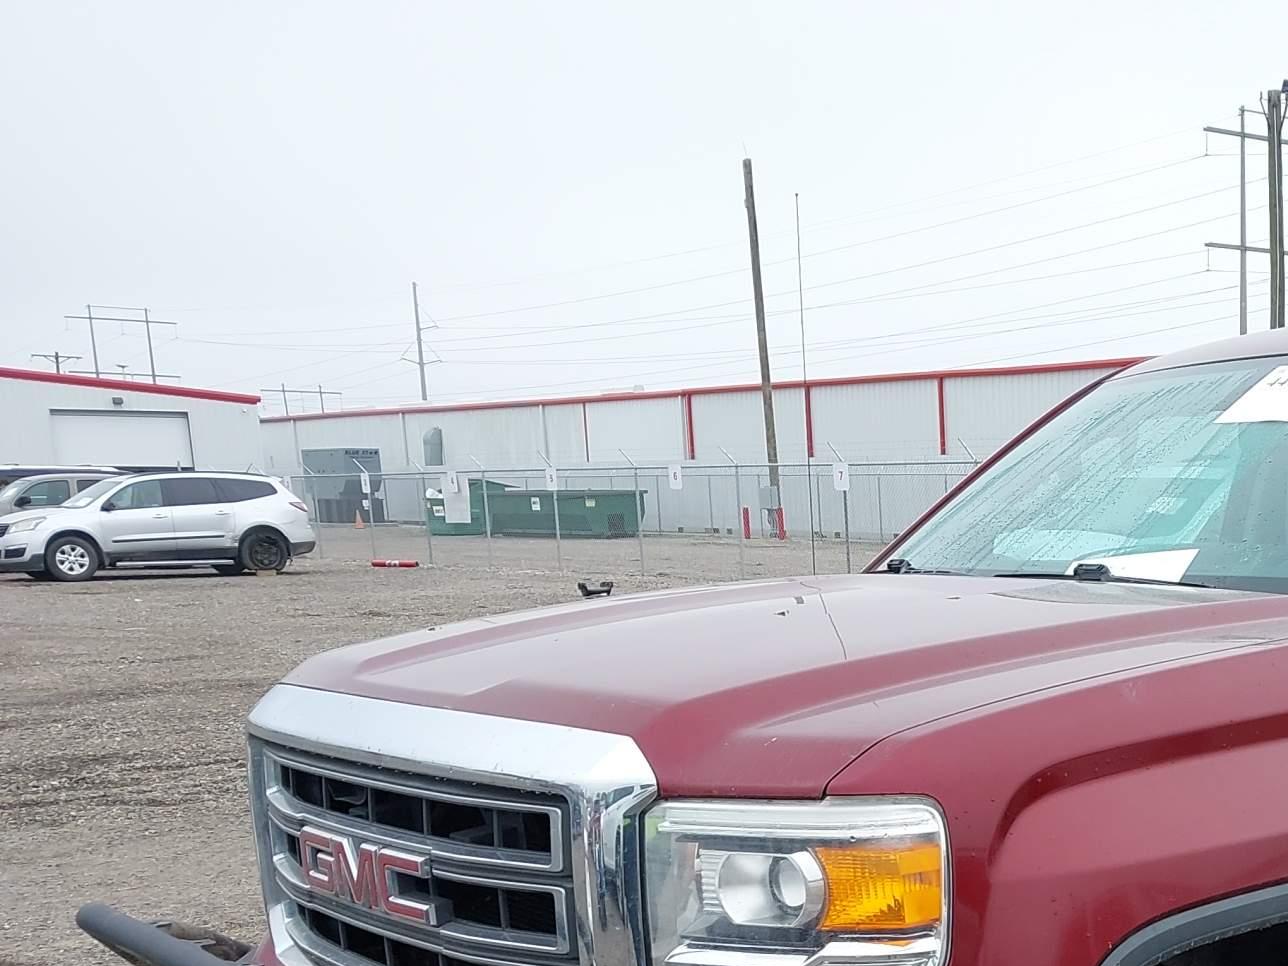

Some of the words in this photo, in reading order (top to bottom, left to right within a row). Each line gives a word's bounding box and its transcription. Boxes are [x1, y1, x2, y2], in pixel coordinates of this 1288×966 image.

[673, 471, 678, 481] 6
[838, 470, 844, 481] 7
[300, 826, 438, 926] GMC
